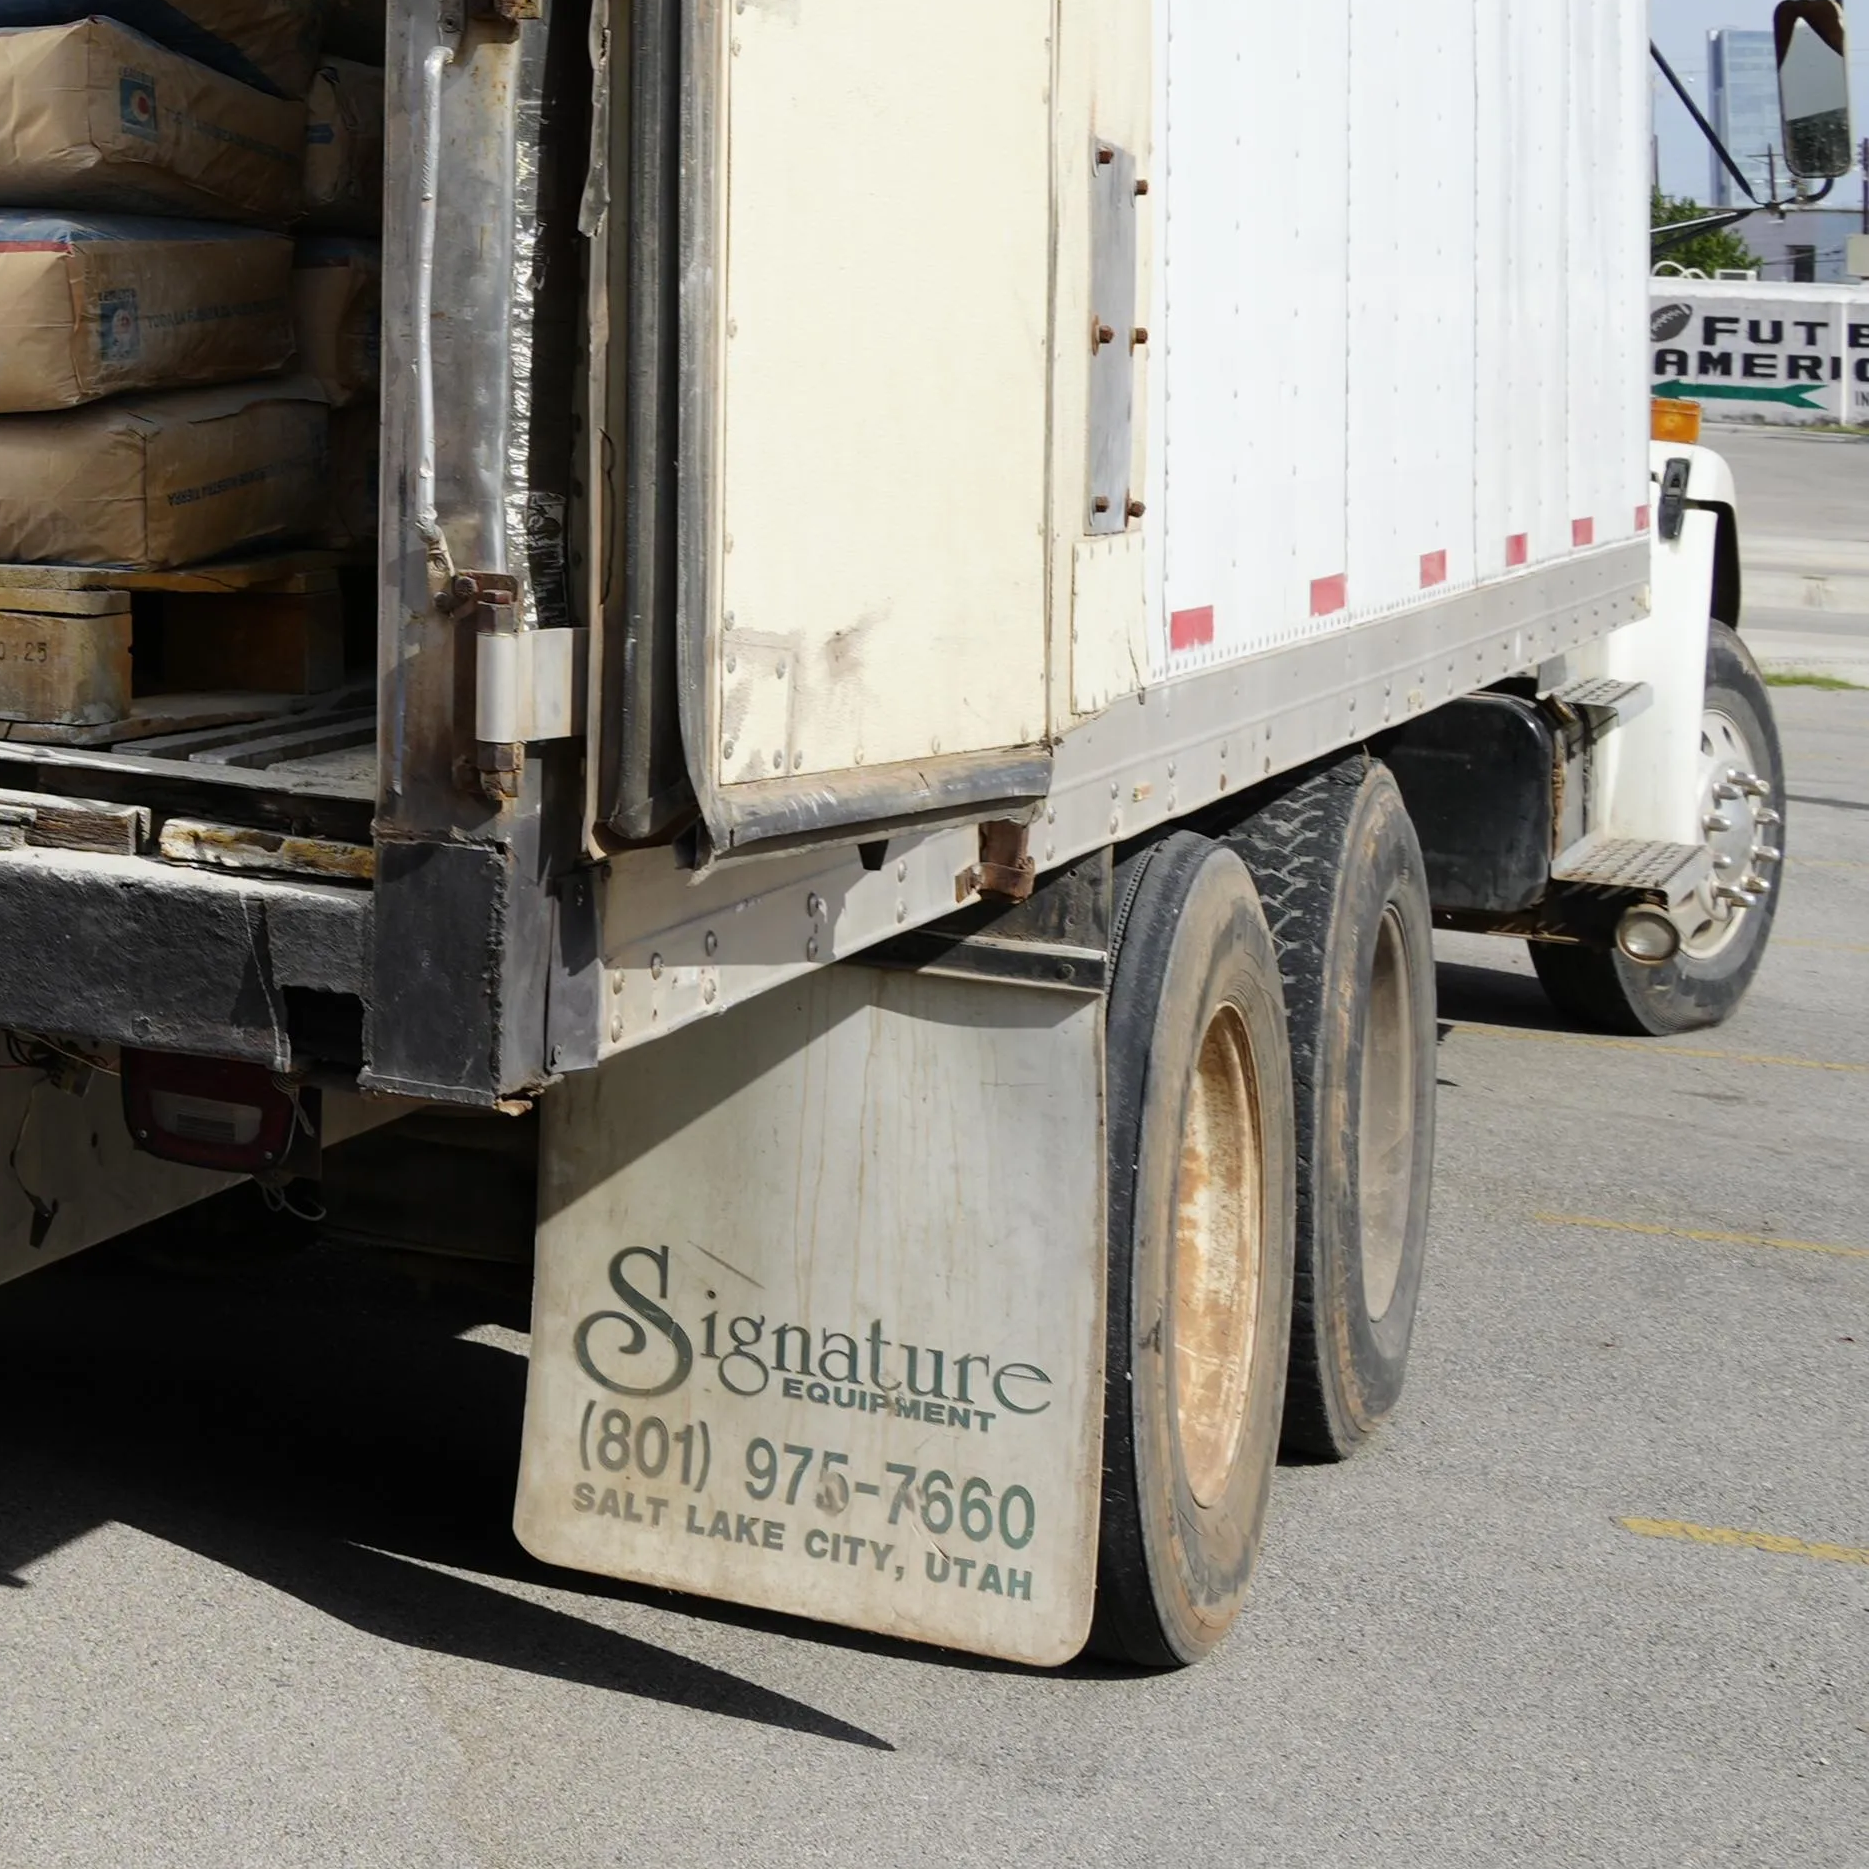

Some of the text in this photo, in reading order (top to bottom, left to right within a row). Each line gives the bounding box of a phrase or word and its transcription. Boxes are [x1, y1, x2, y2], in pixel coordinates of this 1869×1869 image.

[573, 1245, 1052, 1416] Signature
[782, 1379, 997, 1432] EQUIPMENT
[572, 1482, 1033, 1602] SALT LAKE CITY, UTAH
[579, 1400, 1036, 1550] (801) 975-7660
